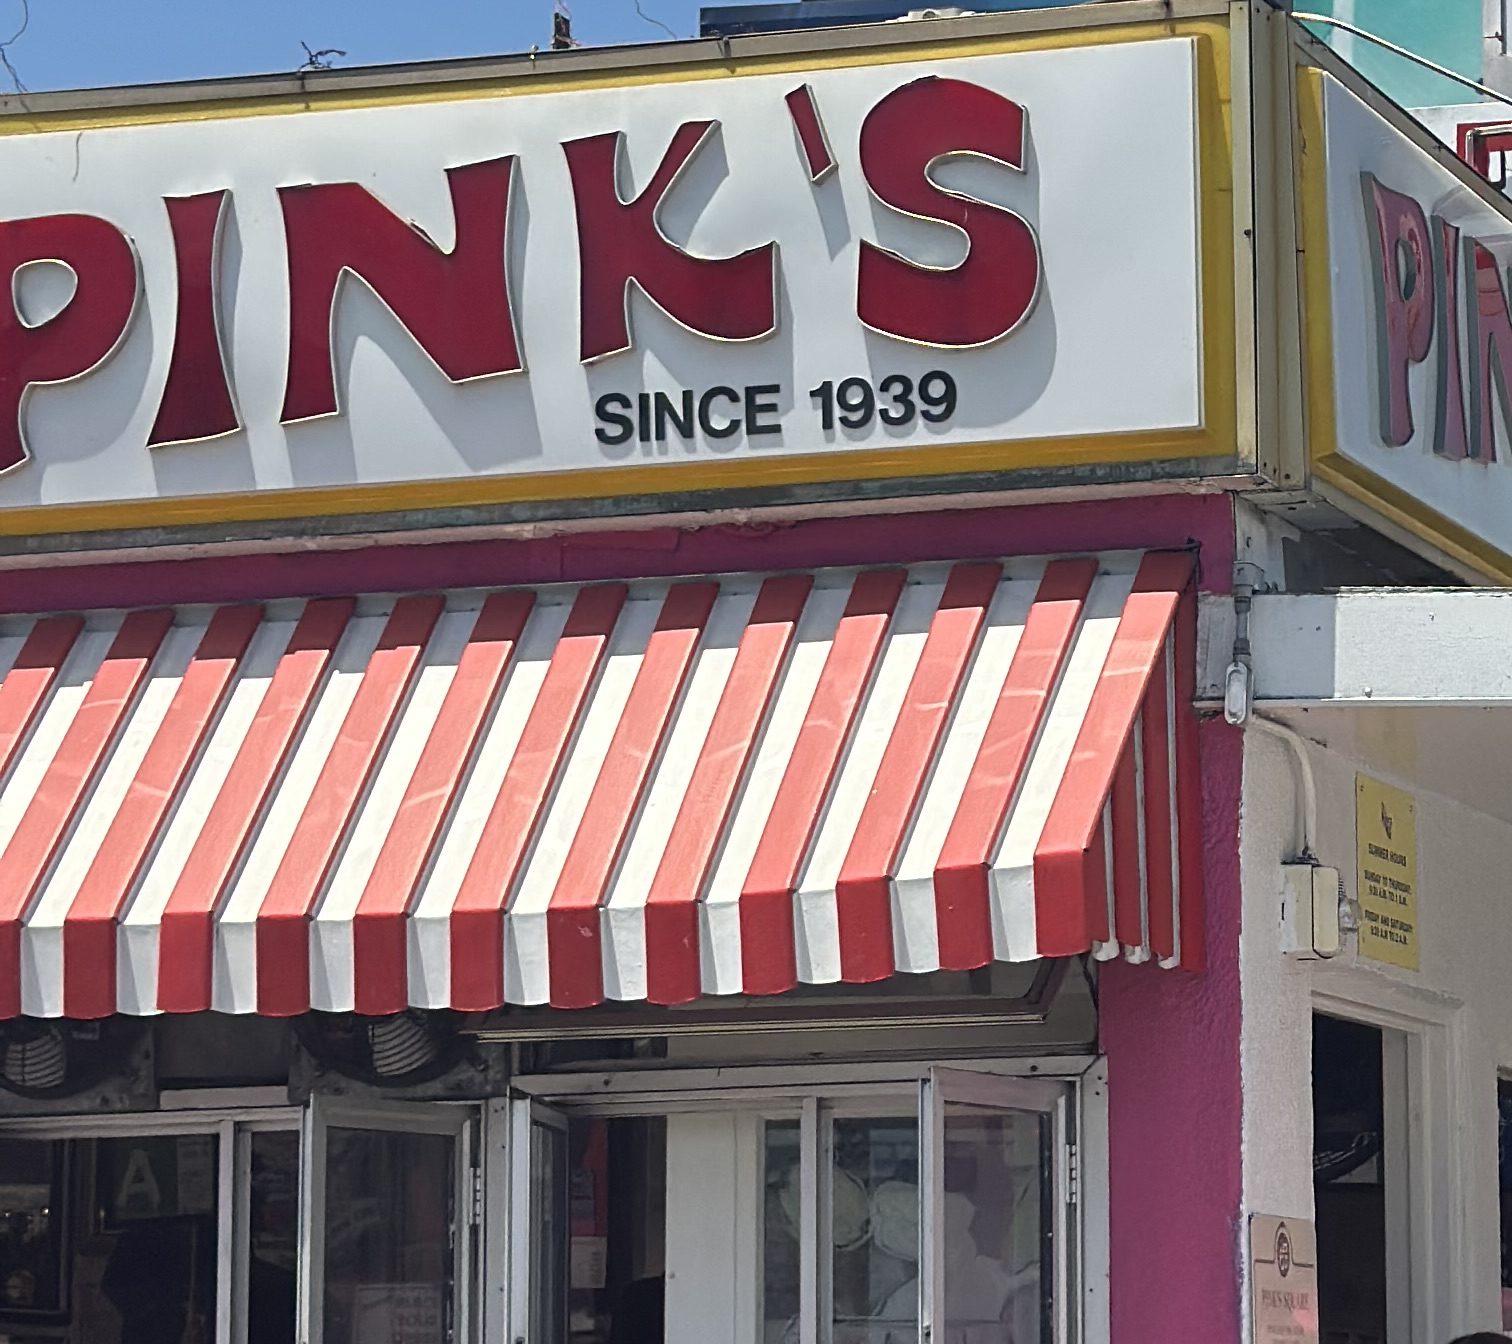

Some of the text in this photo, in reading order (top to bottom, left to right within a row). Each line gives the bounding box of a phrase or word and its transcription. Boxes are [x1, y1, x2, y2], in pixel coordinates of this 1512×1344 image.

[0, 75, 1043, 476] PINK'S
[594, 370, 958, 447] SINCE 1939
